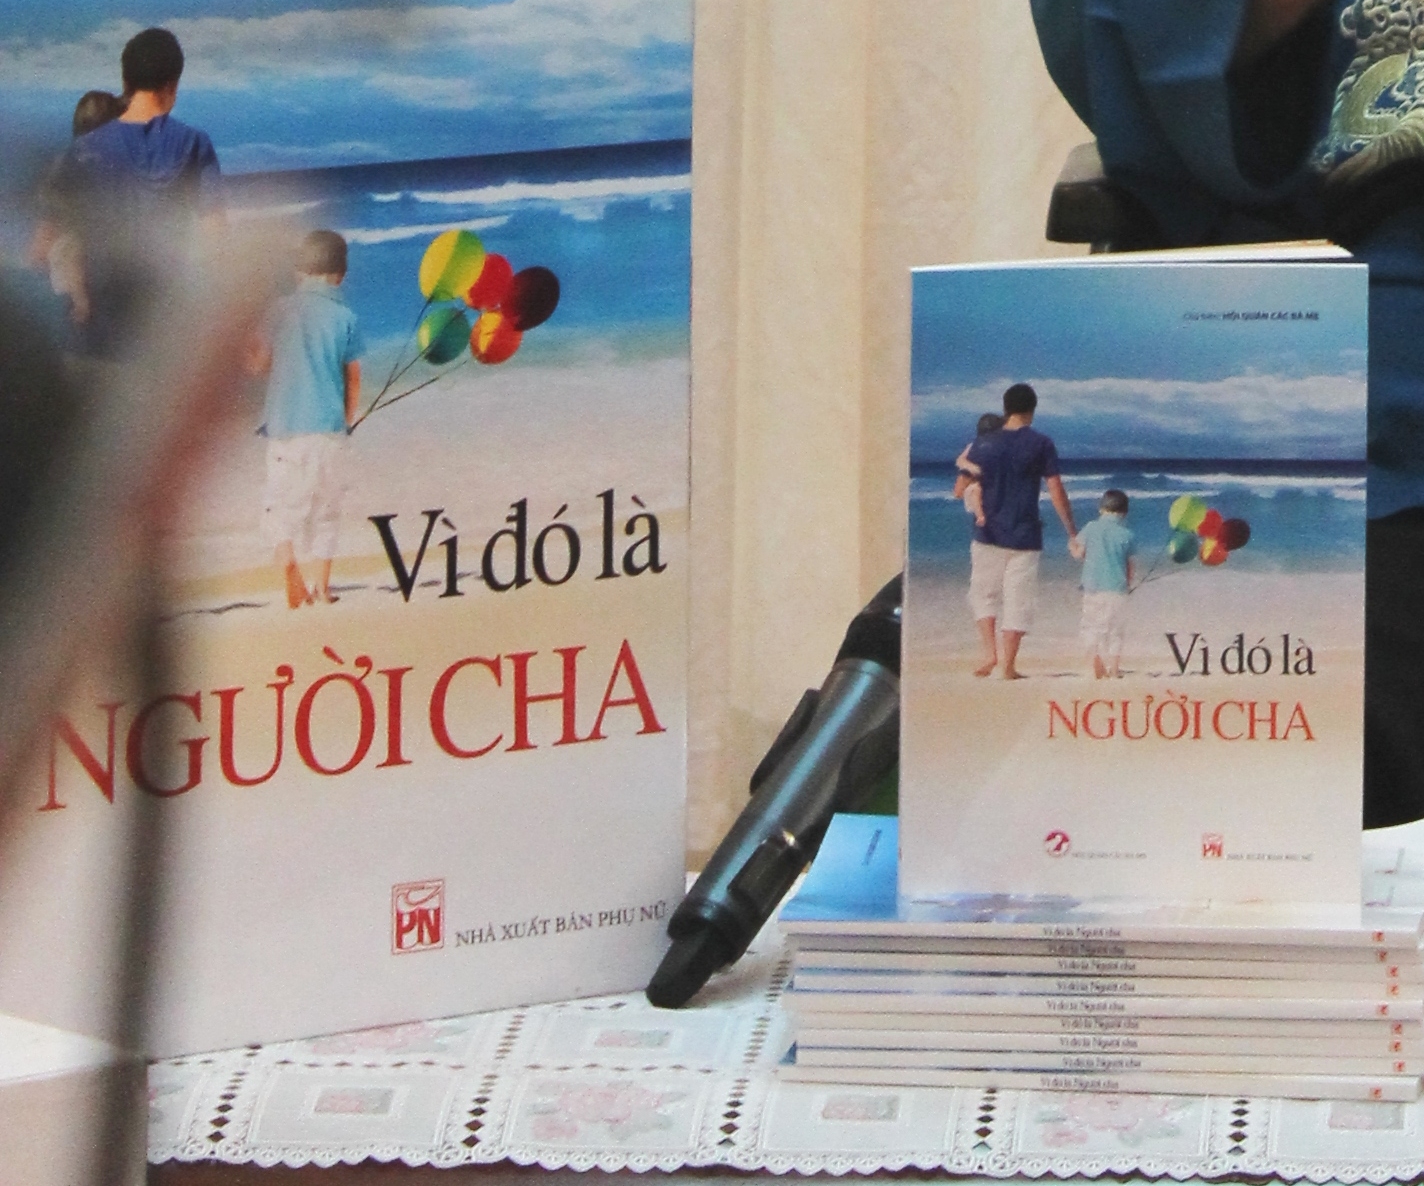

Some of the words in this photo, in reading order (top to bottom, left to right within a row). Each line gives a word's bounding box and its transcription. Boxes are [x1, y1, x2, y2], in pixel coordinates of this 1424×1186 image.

[367, 508, 465, 603] Vì
[481, 497, 582, 592] đó
[594, 488, 668, 581] là
[1164, 632, 1211, 675] Vì
[1220, 632, 1272, 675] đó
[1280, 633, 1316, 675] là
[36, 645, 414, 813] NGƯỜI
[429, 638, 668, 759] CHA
[1047, 689, 1205, 741] NGƯỜI
[1211, 700, 1315, 741] CHA
[455, 921, 496, 947] NHÀ
[500, 915, 550, 941] XUẤT
[554, 911, 592, 933] BẢN
[598, 907, 636, 927] PHỤ
